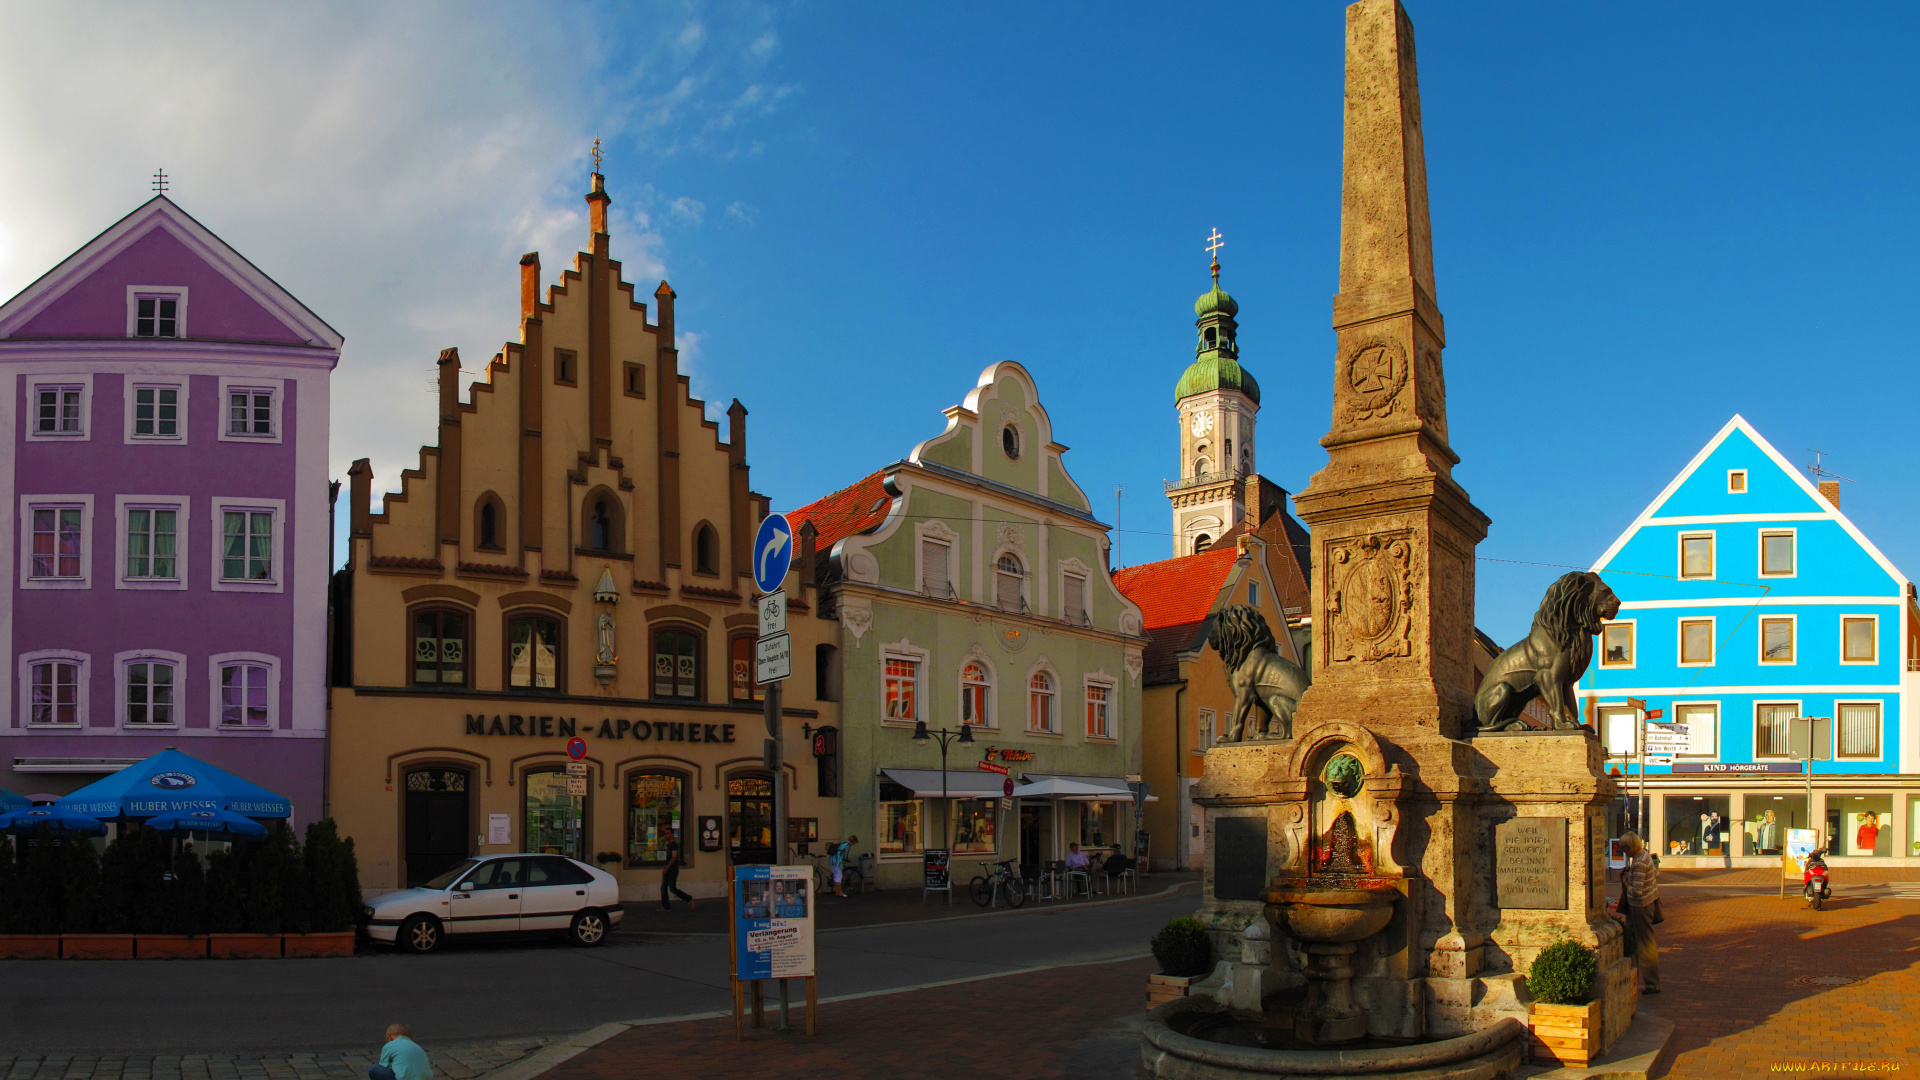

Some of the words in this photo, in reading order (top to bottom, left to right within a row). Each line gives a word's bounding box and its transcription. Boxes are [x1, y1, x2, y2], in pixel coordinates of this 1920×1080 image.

[767, 620, 777, 630] frei
[764, 642, 780, 652] Zufahrt
[768, 666, 777, 674] frei
[1001, 749, 1035, 761] Tchibo
[1730, 763, 1769, 771] HÖRGERÄTE
[90, 802, 117, 813] WEISSES
[130, 801, 168, 811] HUBER
[171, 800, 217, 811] WEISSES
[231, 801, 252, 811] HUBER
[253, 803, 284, 813] WEISSES
[1504, 846, 1552, 854] SCHWEIGEN
[1513, 876, 1540, 884] ALLES
[750, 927, 798, 938] Verlängerung
